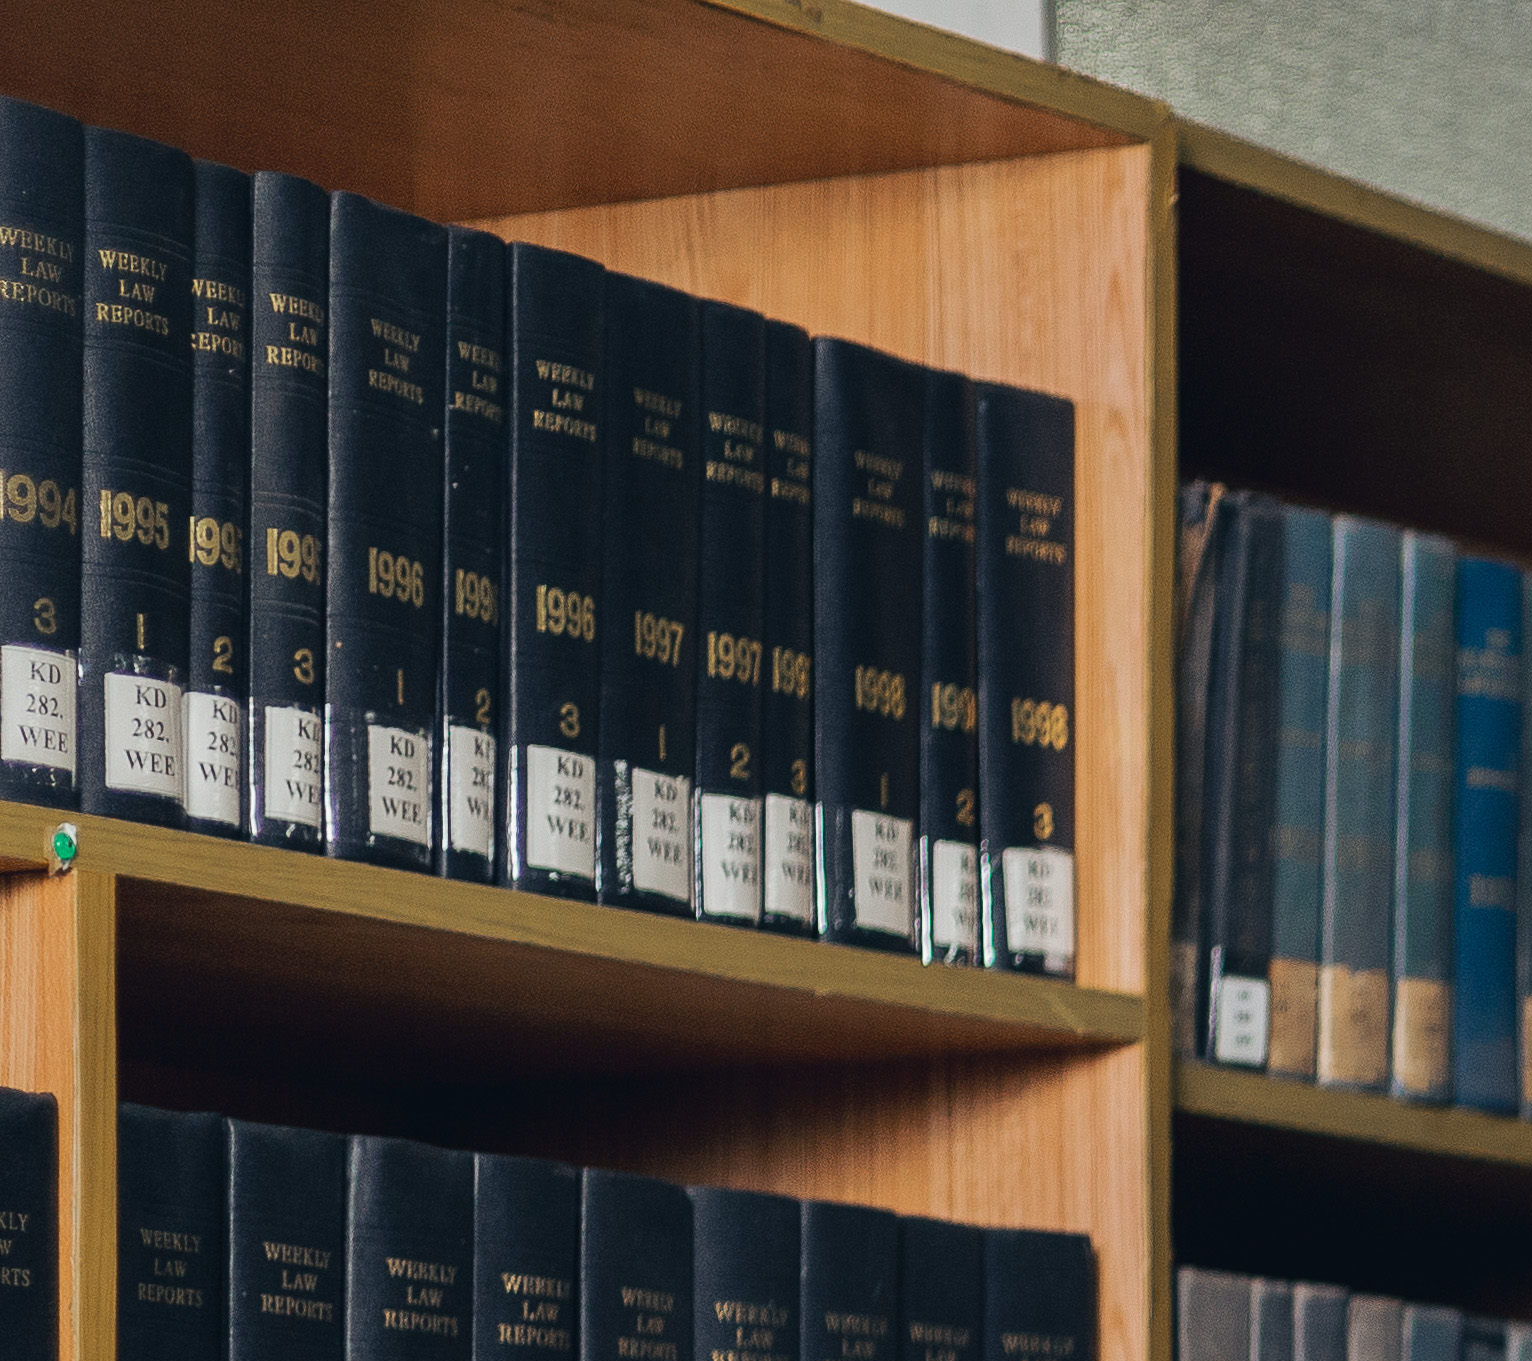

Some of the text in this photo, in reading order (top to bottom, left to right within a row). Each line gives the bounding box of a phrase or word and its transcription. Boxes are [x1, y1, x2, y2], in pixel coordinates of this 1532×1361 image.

[0, 226, 74, 263] WEEKLY
[21, 257, 63, 283] LAW
[98, 249, 169, 283] WEEKLY
[0, 279, 77, 317] REPORTS
[118, 278, 156, 303] LAW
[96, 302, 170, 335] REPORTS
[206, 306, 241, 332] LAW
[288, 322, 319, 347] LAW
[370, 317, 422, 352] WEEKLY
[383, 347, 411, 373] LAW
[535, 358, 596, 392] WEEKLY
[367, 369, 424, 406] REPORTS
[551, 387, 585, 412] LAW
[533, 408, 598, 444] REPORTS
[100, 489, 170, 550] 1995
[368, 546, 425, 609] 1996
[33, 597, 58, 635] 3
[535, 582, 597, 644] 1996
[634, 609, 686, 669] 1997
[212, 635, 235, 675] 2
[293, 648, 315, 685] 3
[706, 629, 764, 687] 1997
[29, 659, 62, 685] KD
[26, 692, 64, 720] 282.
[134, 684, 168, 709] KD
[474, 687, 492, 725] 2
[130, 717, 170, 744] 282.
[559, 701, 581, 739] 3
[18, 724, 69, 754] WEE
[390, 734, 416, 759] KD
[123, 749, 176, 777] WEE
[556, 754, 584, 780] KD
[729, 741, 751, 780] 2
[386, 765, 419, 791] 282.
[381, 795, 423, 825] WEE
[553, 785, 586, 811] 282.
[546, 814, 590, 844] WEE
[139, 1227, 203, 1253] WEEKLY
[153, 1256, 188, 1278] LAW
[262, 1240, 333, 1271] WEEKLY
[386, 1256, 457, 1285] WEEKLY
[137, 1281, 205, 1308] REPORTS
[281, 1268, 319, 1293] LAW
[260, 1292, 335, 1324] REPORTS
[406, 1285, 444, 1309] LAW
[523, 1300, 561, 1323] LAW
[383, 1308, 460, 1338] REPORTS
